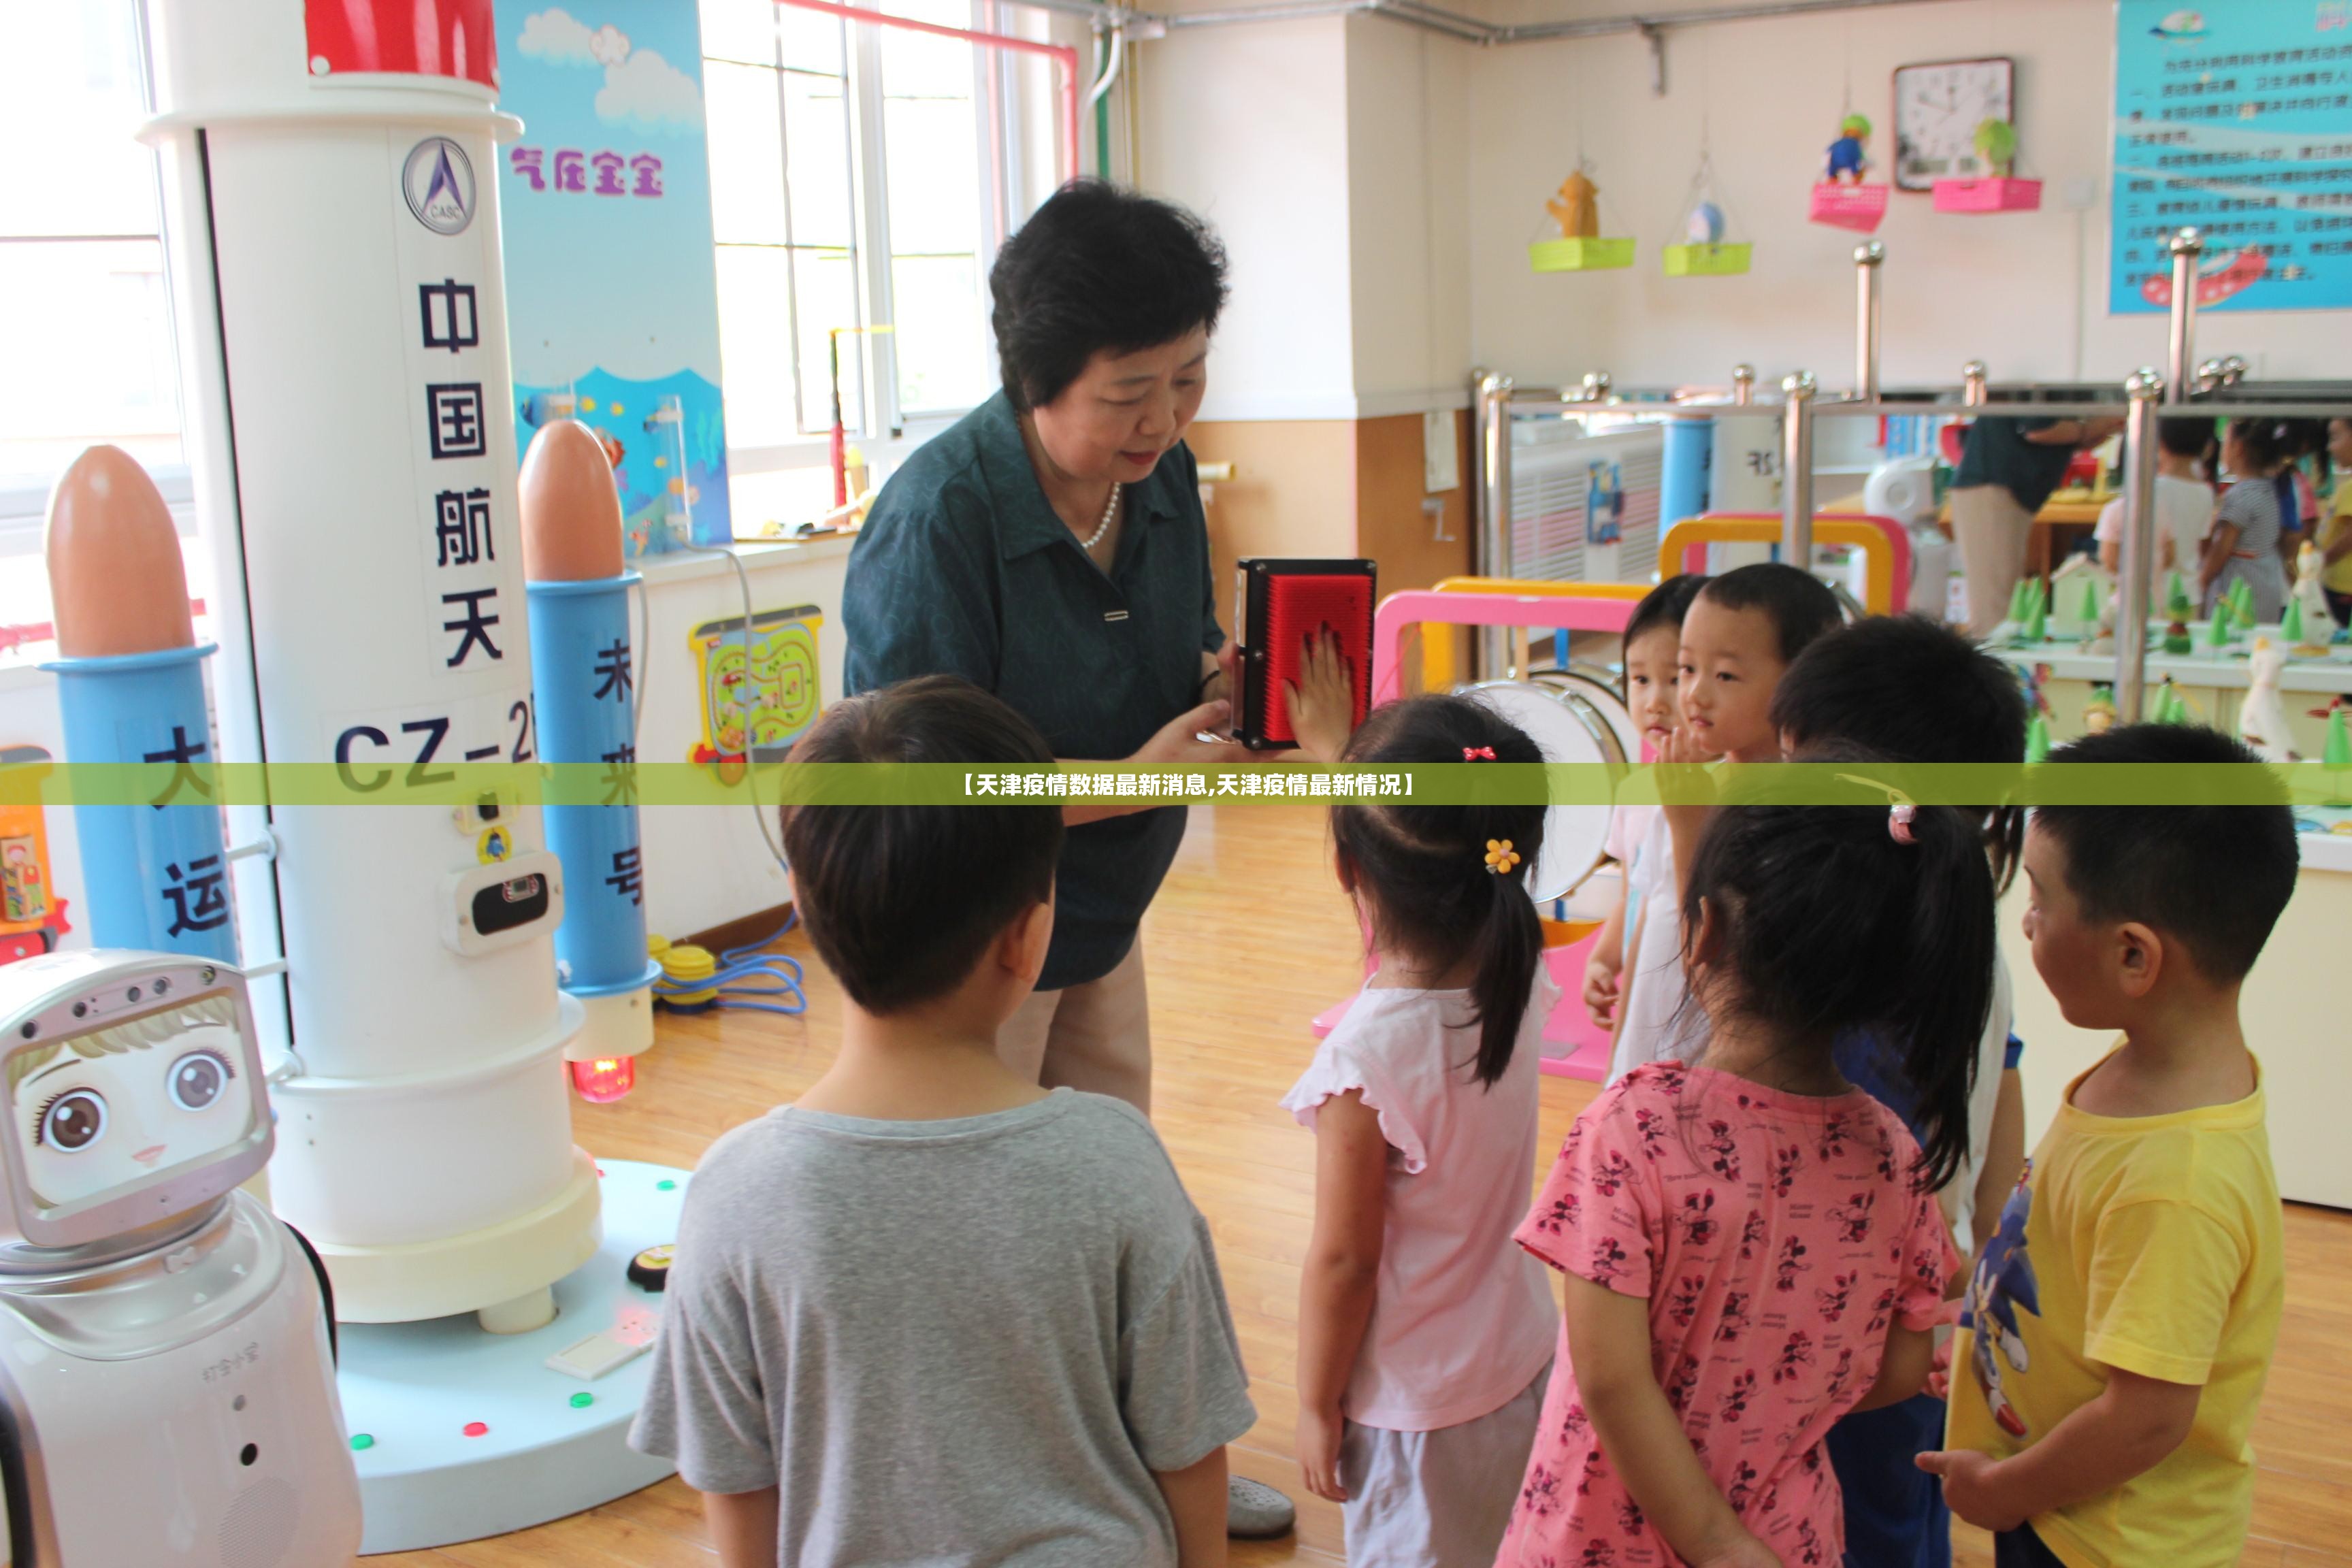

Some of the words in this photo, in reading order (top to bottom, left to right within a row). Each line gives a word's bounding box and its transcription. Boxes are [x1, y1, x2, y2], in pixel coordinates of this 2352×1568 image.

[430, 205, 461, 220] CASC
[511, 148, 664, 196] 气压宝宝
[419, 278, 503, 668] 中国航天
[144, 725, 228, 938] 大运
[593, 638, 642, 906] 未来号
